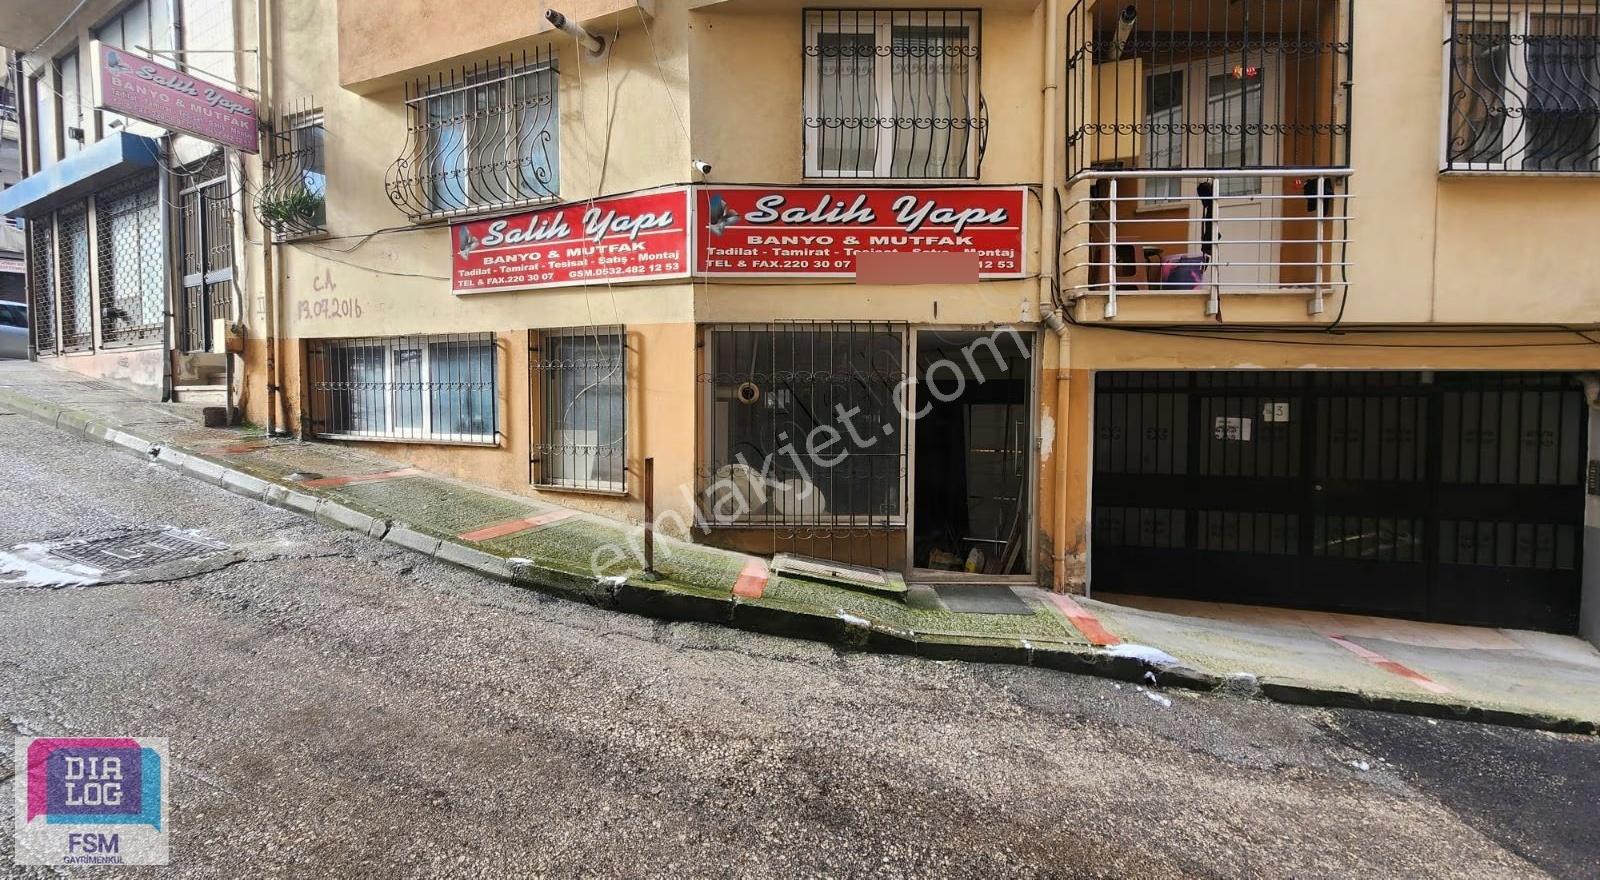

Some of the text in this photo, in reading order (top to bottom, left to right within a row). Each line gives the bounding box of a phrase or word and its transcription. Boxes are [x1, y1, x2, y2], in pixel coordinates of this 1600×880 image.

[136, 66, 198, 97] Salih
[111, 76, 169, 102] BANYO
[176, 98, 185, 108] &
[190, 104, 249, 129] MUTFAK
[744, 194, 1008, 233] Salih Yapı
[481, 207, 674, 248] Salih Yapı
[747, 235, 974, 245] BANYO & MUTFAK
[458, 267, 491, 278] Tadilat
[499, 263, 540, 274] Tamirat
[548, 258, 588, 270] Tesisat
[638, 250, 680, 263] Montaj
[483, 241, 647, 265] BANYO & MUTFAK
[705, 260, 1014, 269] TEL & FAX.220 30 07 12 53
[706, 247, 758, 256] Tadilat
[772, 247, 830, 257] Tamirat
[458, 278, 476, 287] TEL
[486, 274, 525, 285] FAX.220
[527, 273, 540, 282] 30
[541, 272, 554, 281] 07
[568, 265, 646, 279] GSM.0532.482
[649, 263, 664, 273] 12
[665, 262, 680, 272] 53
[1275, 404, 1284, 417] 3
